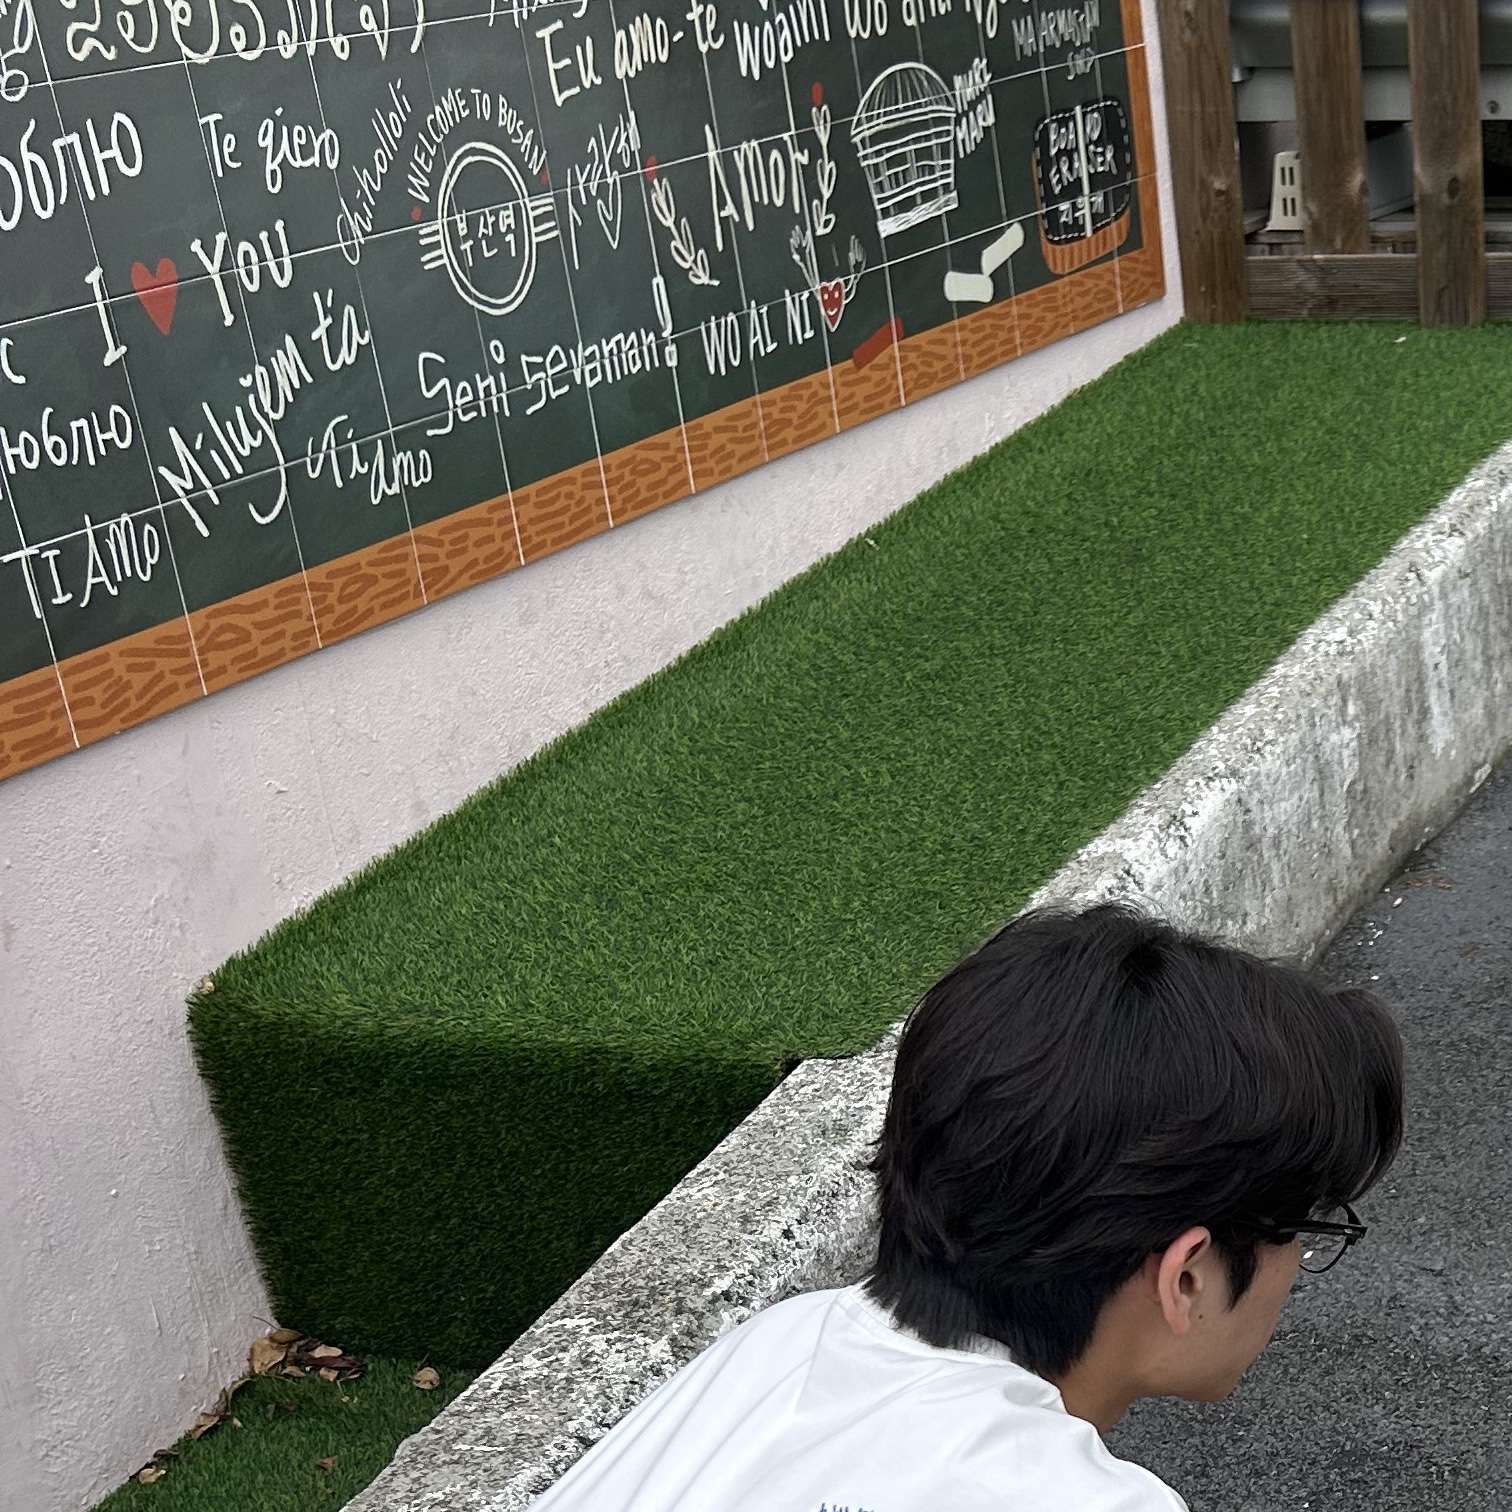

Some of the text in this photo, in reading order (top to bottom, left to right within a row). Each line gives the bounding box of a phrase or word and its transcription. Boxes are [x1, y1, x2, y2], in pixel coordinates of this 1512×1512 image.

[535, 0, 725, 107] Eu amo-te
[200, 113, 242, 178] Te
[408, 88, 547, 204] WELCOME TO BUSAN
[455, 202, 516, 267] 부산역
[701, 288, 815, 376] WO AI NI
[0, 404, 133, 476] юблю
